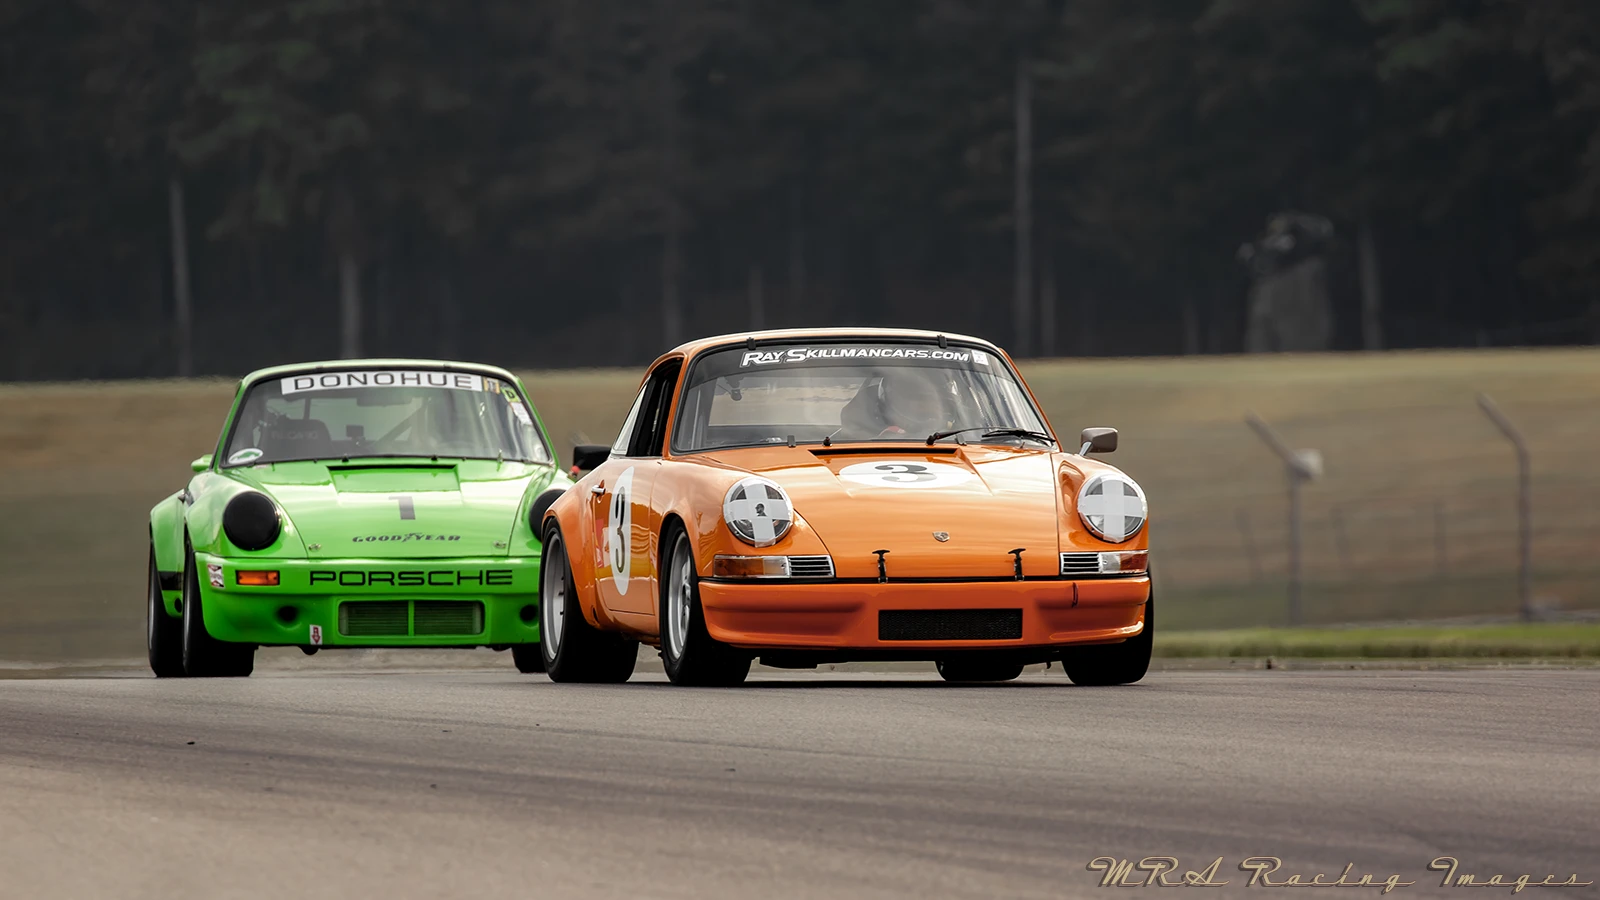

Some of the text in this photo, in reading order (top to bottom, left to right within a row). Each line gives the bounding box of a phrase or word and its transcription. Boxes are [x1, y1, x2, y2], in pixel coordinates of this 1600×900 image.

[741, 352, 784, 366] RAY
[786, 349, 969, 364] SKILLMANCARS.COM
[294, 373, 472, 390] DONOHUE
[875, 464, 937, 482] 3
[388, 496, 416, 520] 1
[352, 533, 461, 542] GOODYEAR
[615, 487, 626, 573] 3
[310, 570, 512, 586] PORSCHE
